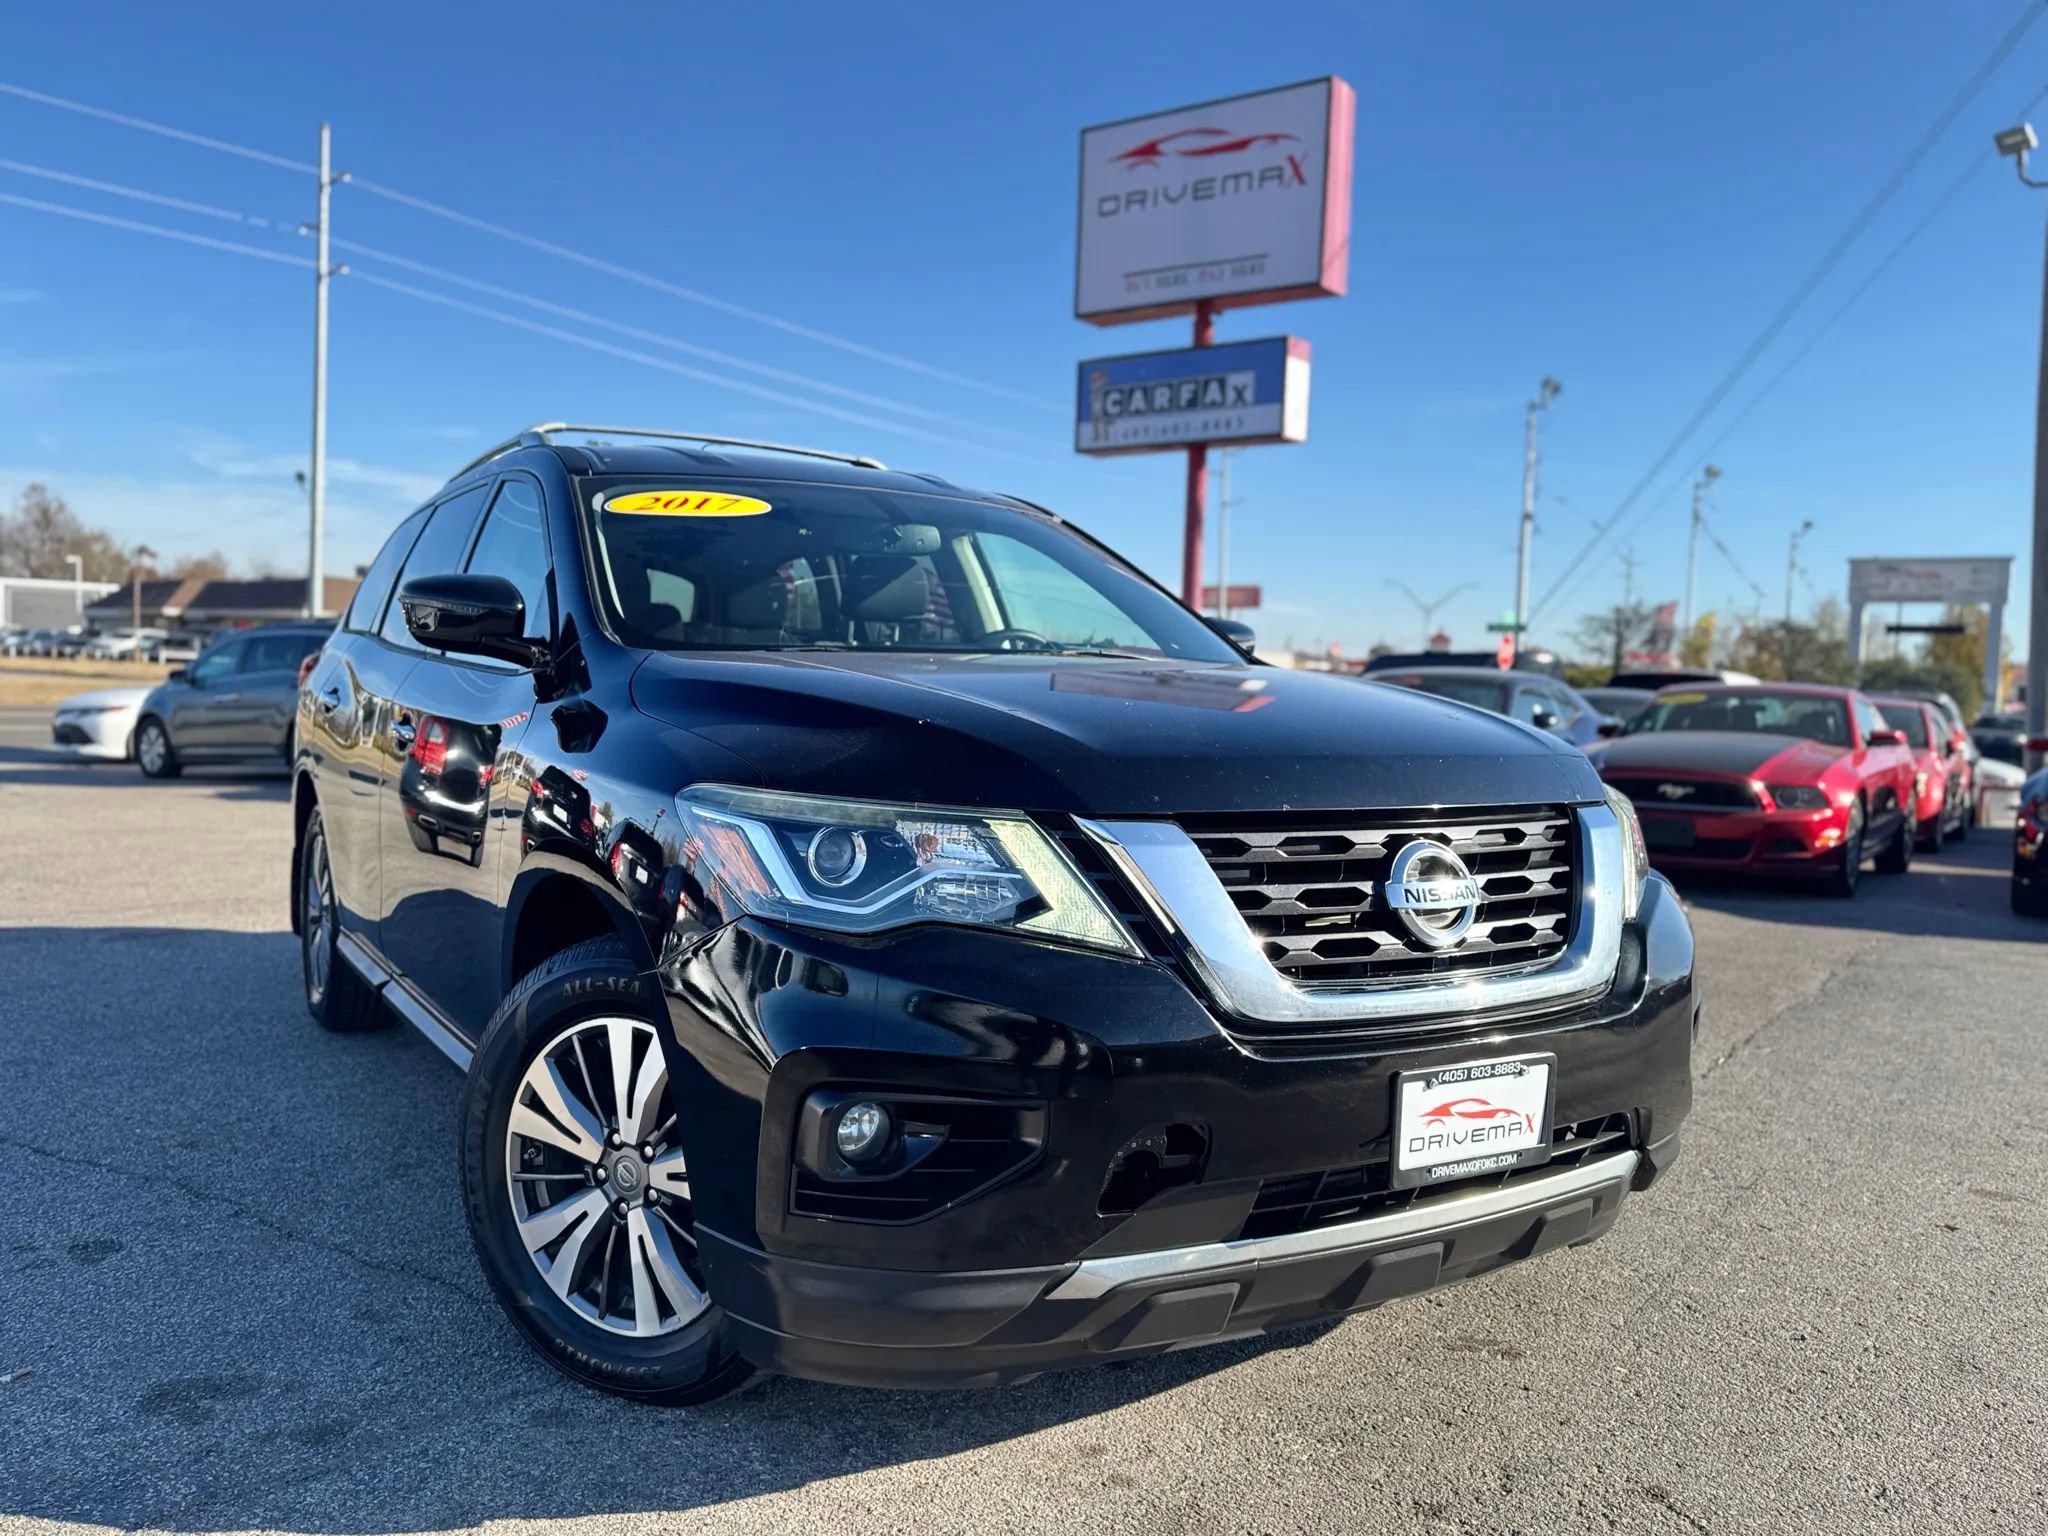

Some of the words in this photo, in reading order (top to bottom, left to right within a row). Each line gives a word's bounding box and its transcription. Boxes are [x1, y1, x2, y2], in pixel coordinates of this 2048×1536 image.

[1097, 152, 1309, 218] DRIVEMAX
[1104, 378, 1249, 416] CARFAX
[632, 497, 743, 511] 2017
[1438, 1069, 1467, 1083] (405)
[1470, 1062, 1521, 1079] 603-8883
[1409, 1112, 1536, 1153] DRIVEMAX
[1431, 1153, 1518, 1179] DRIVEMAXOFOKC.COM
